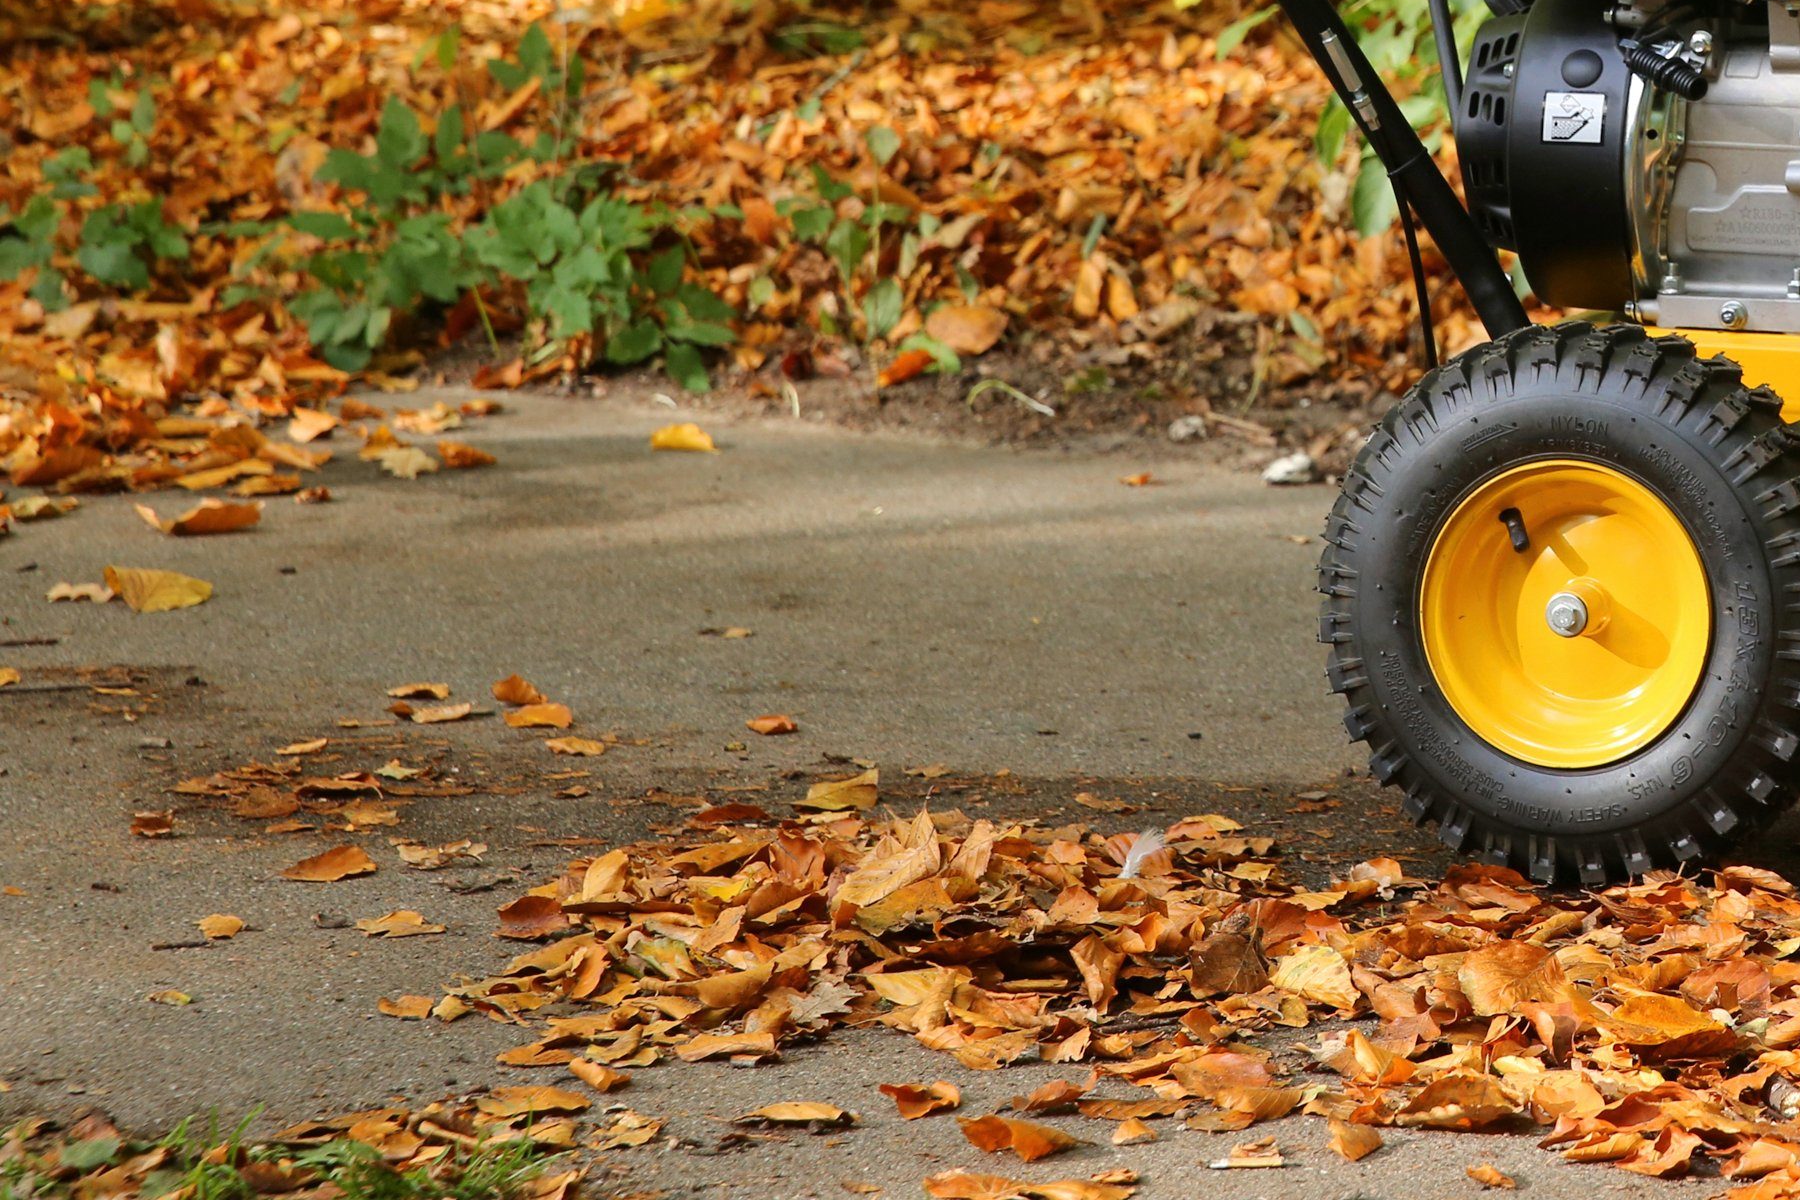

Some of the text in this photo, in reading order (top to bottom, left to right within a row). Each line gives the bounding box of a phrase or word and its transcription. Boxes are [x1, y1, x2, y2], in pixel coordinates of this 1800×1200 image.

[1461, 422, 1501, 447] ROTATION
[1550, 416, 1609, 435] NYLON
[1677, 462, 1708, 496] RATING
[1409, 514, 1432, 550] MADE
[1425, 502, 1440, 517] IN
[1389, 652, 1417, 710] EXPLOSION
[1423, 741, 1448, 767] OVER
[1436, 740, 1474, 775] SERIOUS
[1444, 762, 1494, 799] INFLATION
[1472, 769, 1505, 792] CAUSE
[1568, 801, 1622, 823] SAFETY
